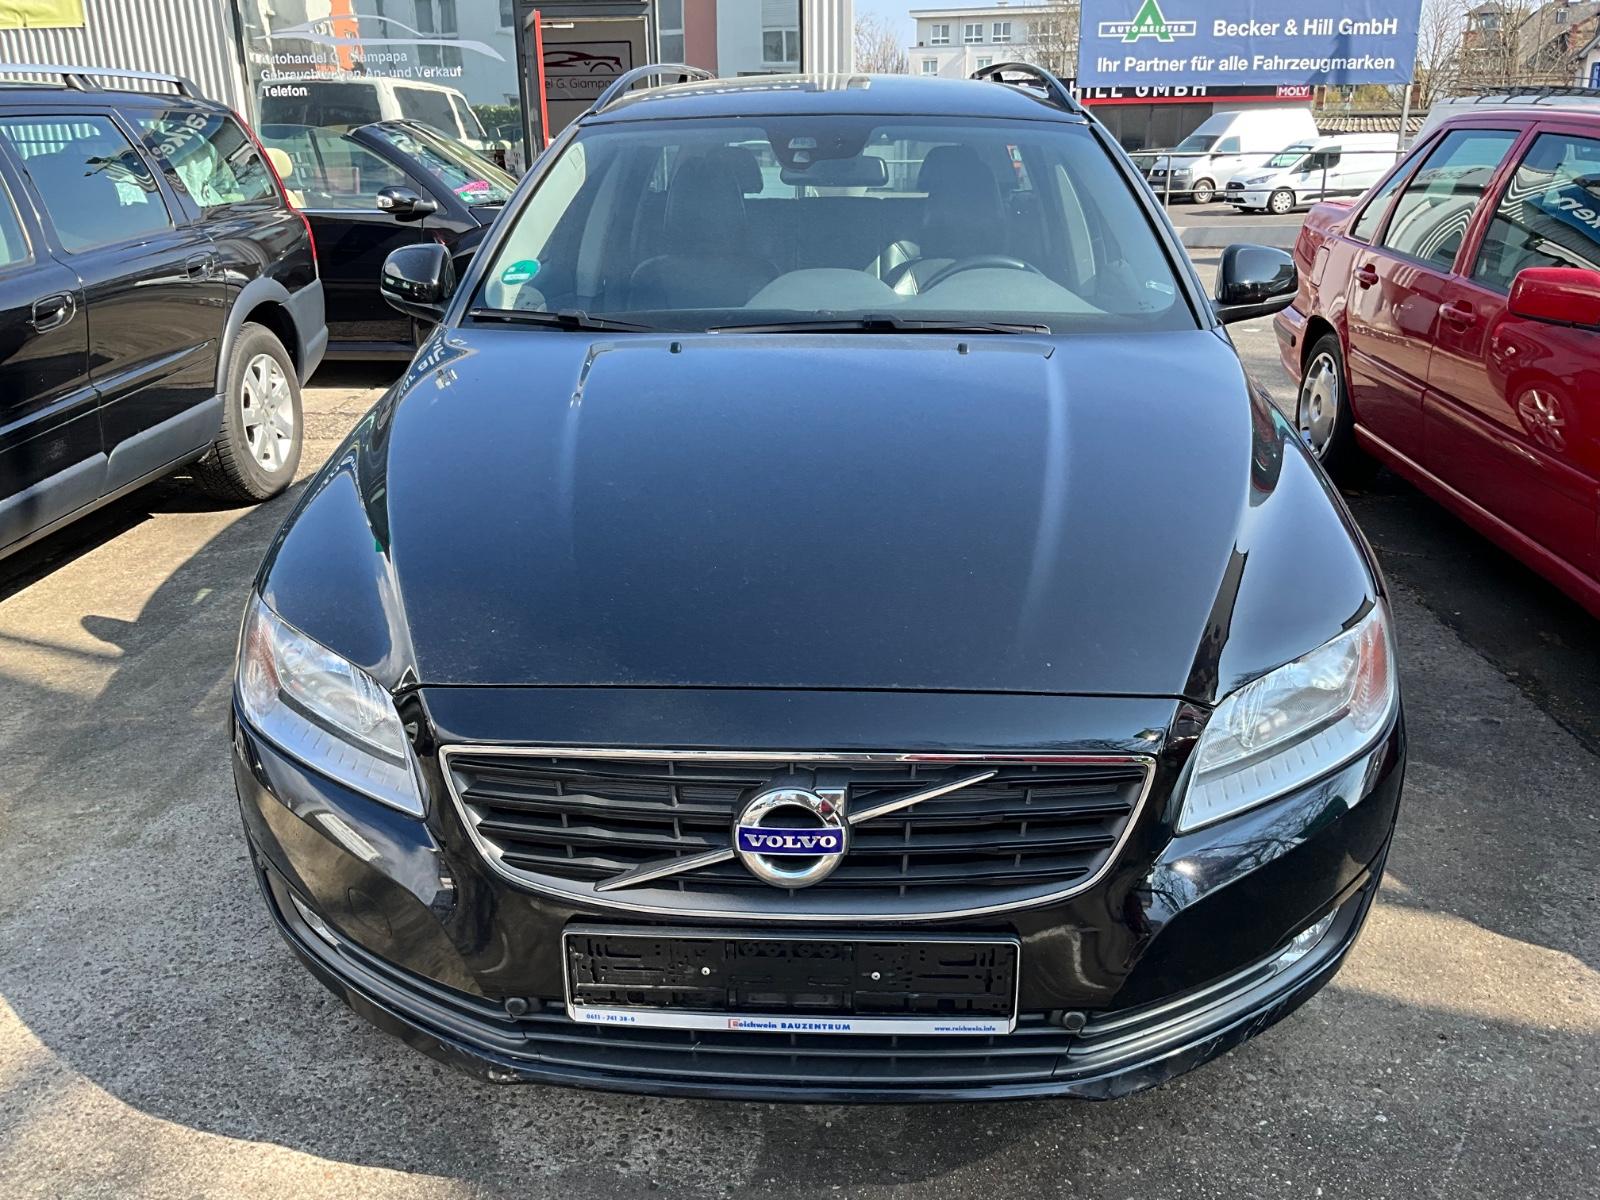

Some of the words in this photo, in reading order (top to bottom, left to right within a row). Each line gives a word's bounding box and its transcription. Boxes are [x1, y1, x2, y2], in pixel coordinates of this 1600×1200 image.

[1110, 25, 1186, 33] AUTOMEISTER
[1213, 19, 1279, 37] Becker
[1284, 19, 1298, 36] &
[1303, 19, 1333, 36] Hill
[1338, 18, 1398, 35] GmbH
[1097, 57, 1120, 72] Ihr
[1124, 57, 1187, 72] Partner
[1191, 56, 1215, 71] für
[1219, 55, 1248, 71] alle
[1253, 54, 1395, 73] Fahrzeugmarken
[365, 68, 386, 79] An-
[391, 66, 412, 78] und
[415, 66, 463, 78] Verkauf
[1278, 86, 1308, 96] MOLY
[744, 833, 837, 849] VOLVO
